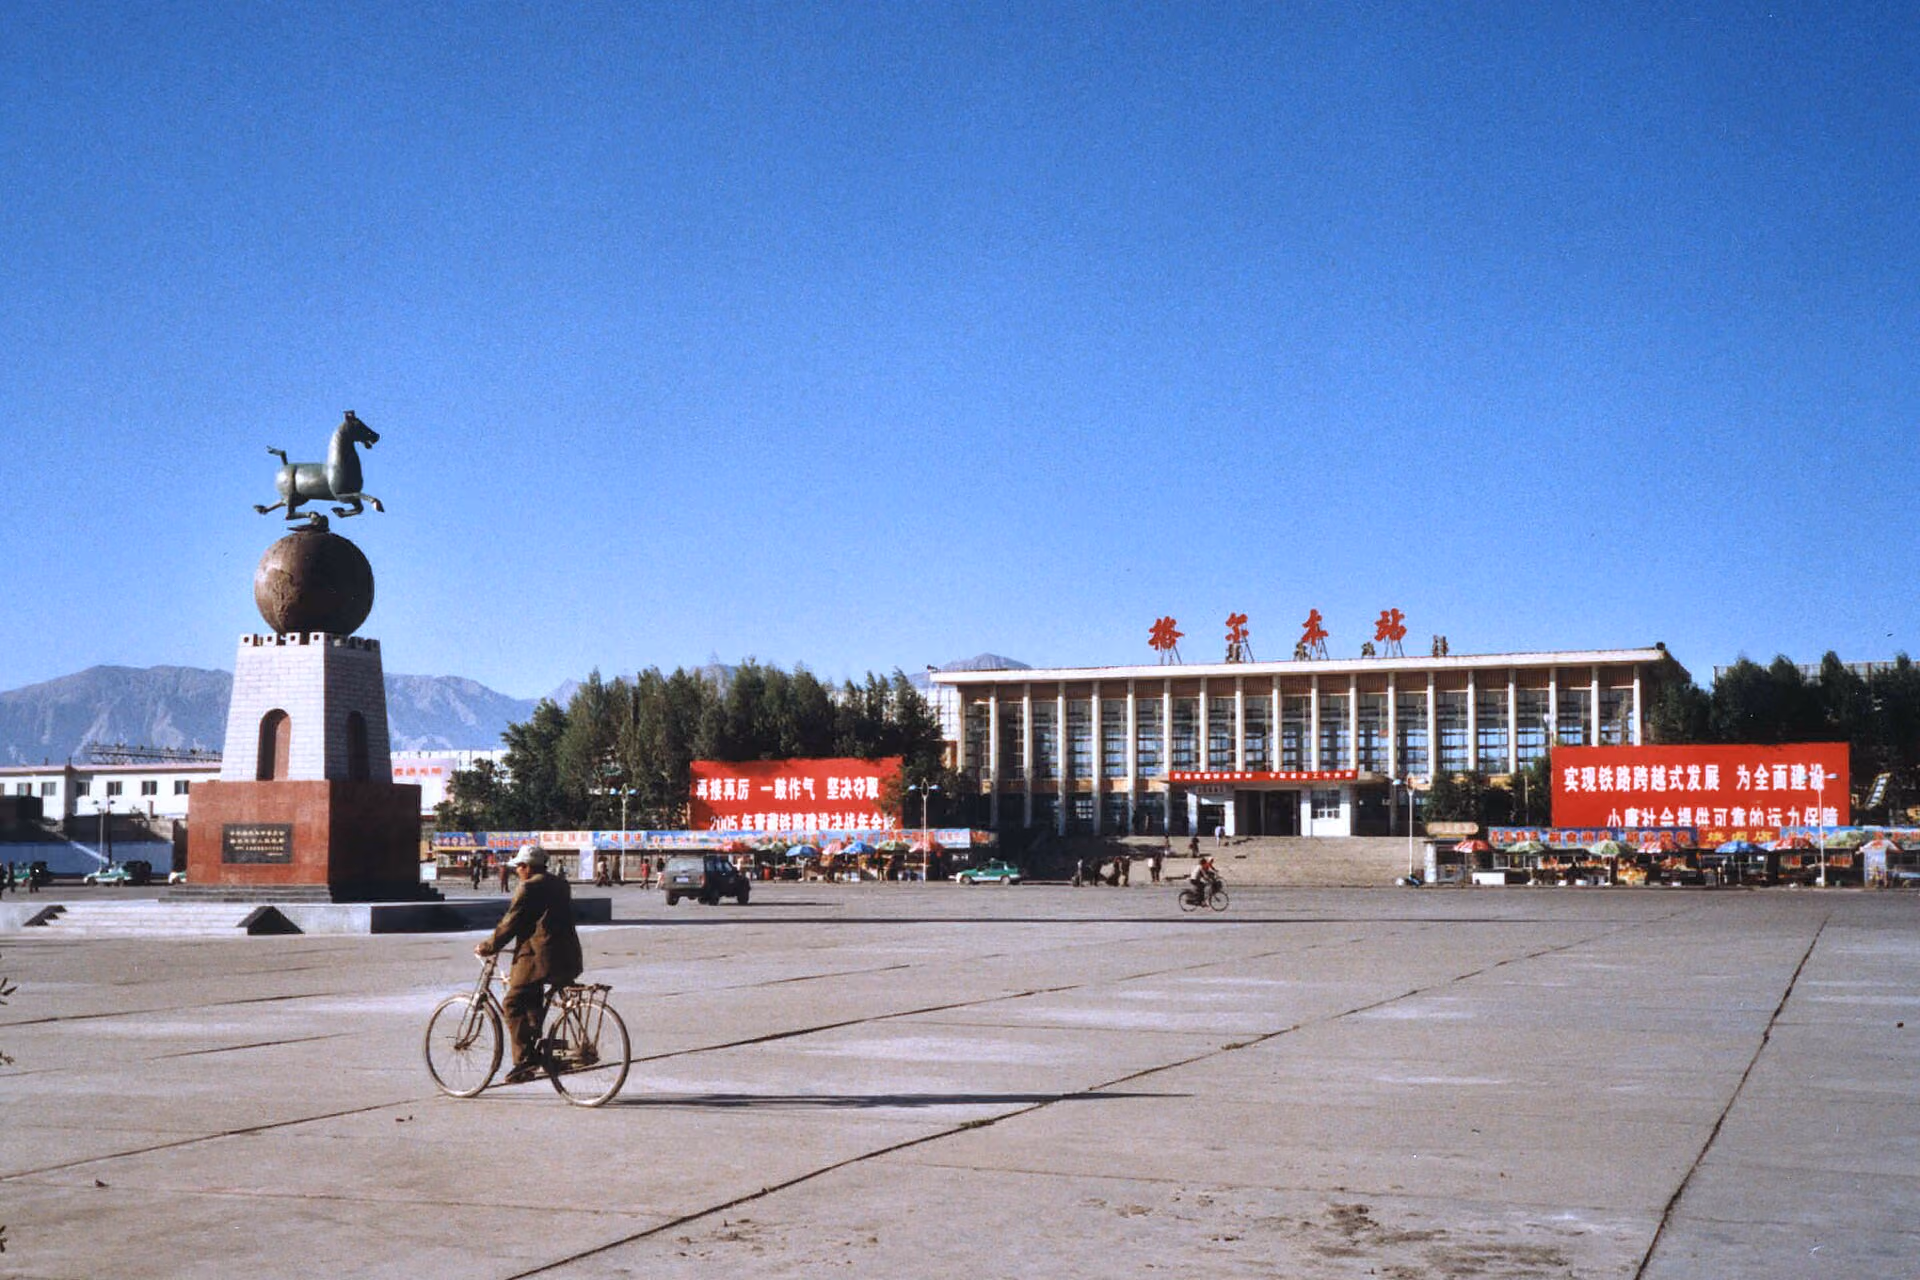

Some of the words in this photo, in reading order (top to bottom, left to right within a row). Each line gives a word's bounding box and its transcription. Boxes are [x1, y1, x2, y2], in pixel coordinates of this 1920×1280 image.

[696, 777, 750, 801] 再接再厉
[760, 776, 816, 801] 一鼓作气
[1564, 764, 1721, 792] 实现铁路跨越式发展
[1736, 763, 1825, 791] 为全面建设
[1606, 806, 1840, 828] 小康社会提供可靠的运力保障
